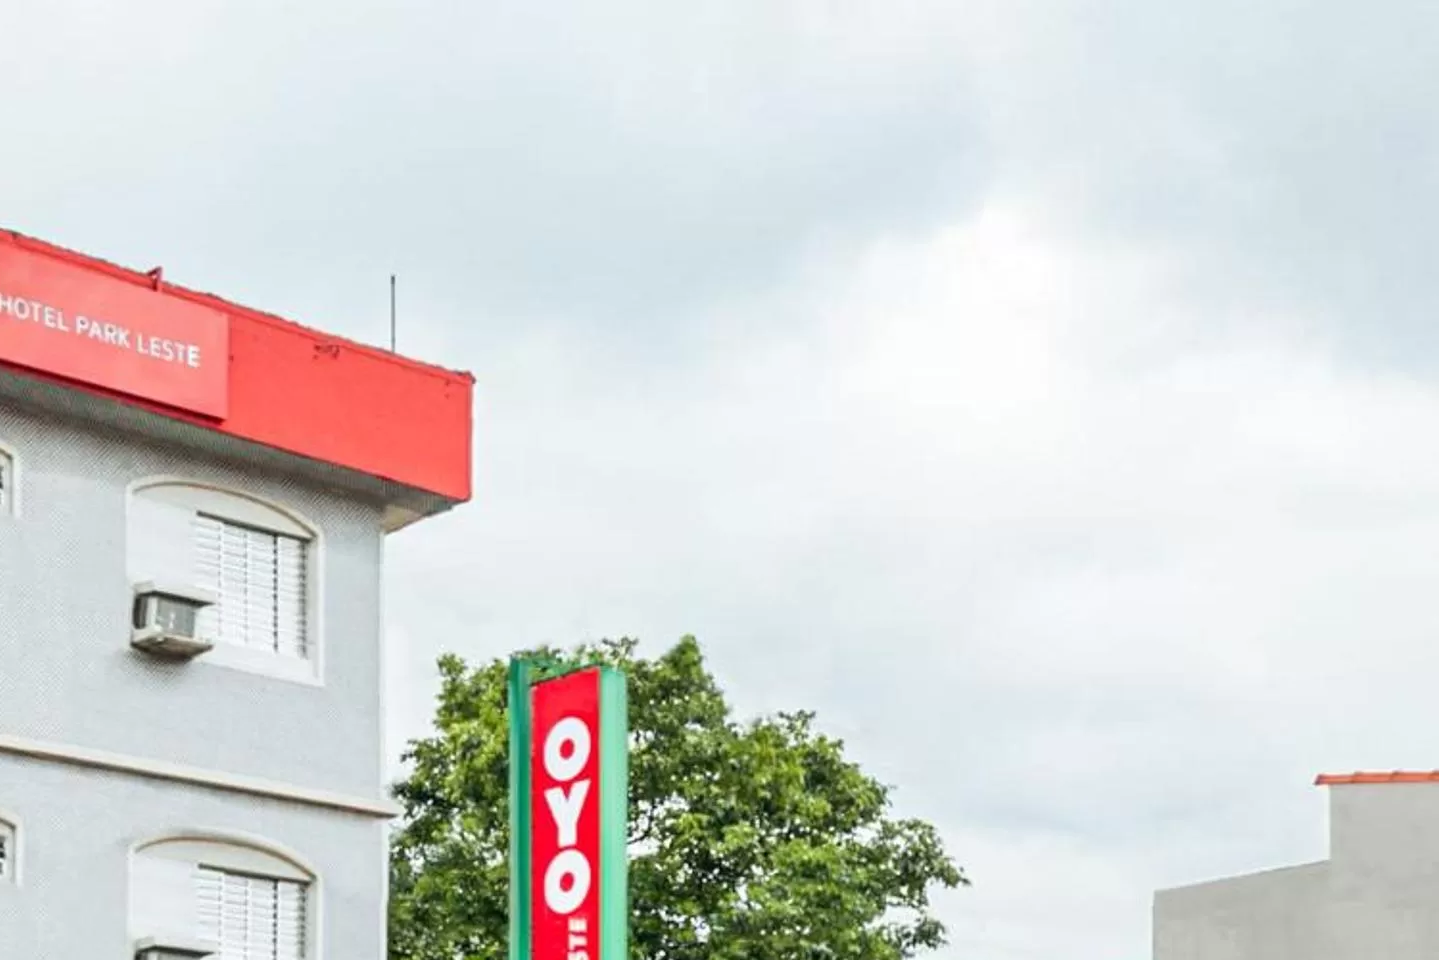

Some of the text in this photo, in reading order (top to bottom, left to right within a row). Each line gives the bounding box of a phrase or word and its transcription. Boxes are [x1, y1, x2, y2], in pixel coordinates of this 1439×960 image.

[76, 315, 130, 348] PARK
[136, 333, 200, 368] LESTE
[543, 716, 591, 914] OYO
